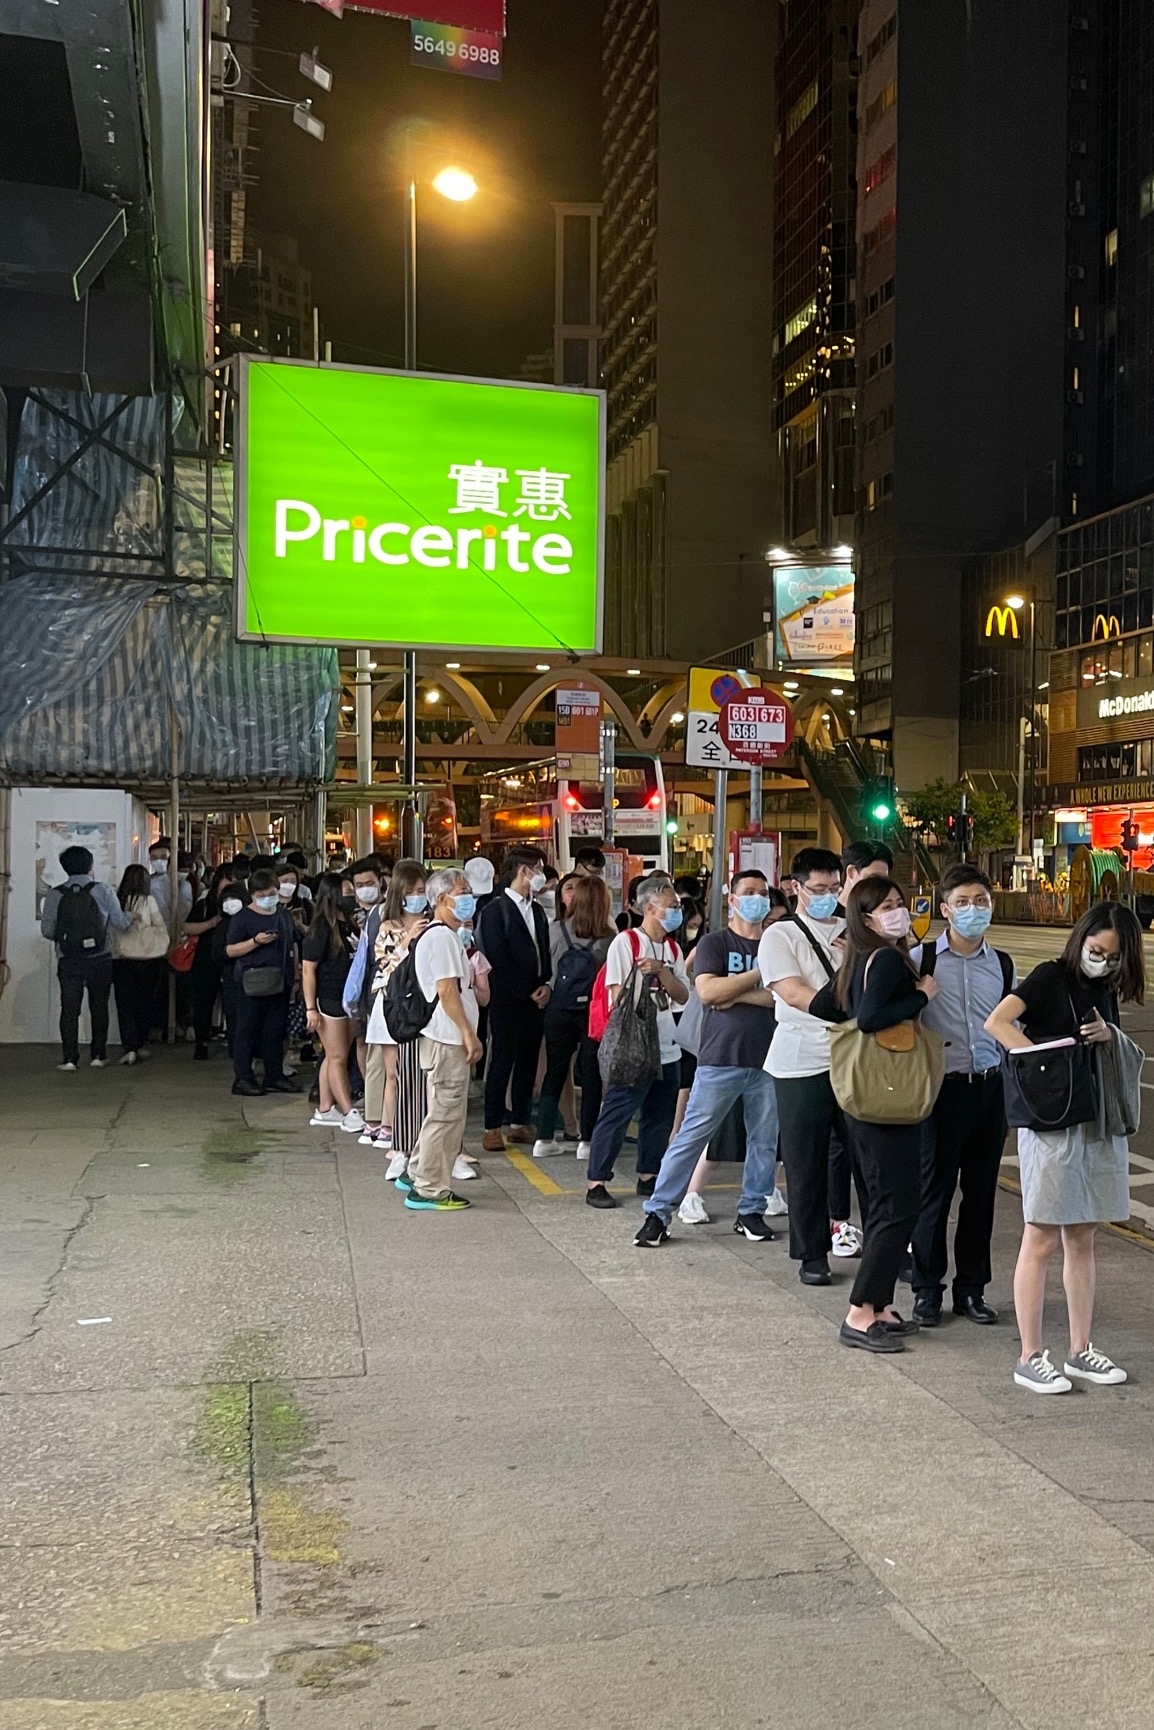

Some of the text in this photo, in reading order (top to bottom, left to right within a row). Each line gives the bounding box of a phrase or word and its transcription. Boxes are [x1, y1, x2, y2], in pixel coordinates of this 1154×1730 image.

[414, 34, 500, 65] 5649 6988
[448, 459, 572, 521] 實惠
[275, 499, 573, 574] Pricerite
[732, 707, 783, 722] 603 673
[729, 723, 756, 739] N368
[1098, 785, 1112, 802] NEW
[1113, 781, 1154, 801] EXPERIENCE
